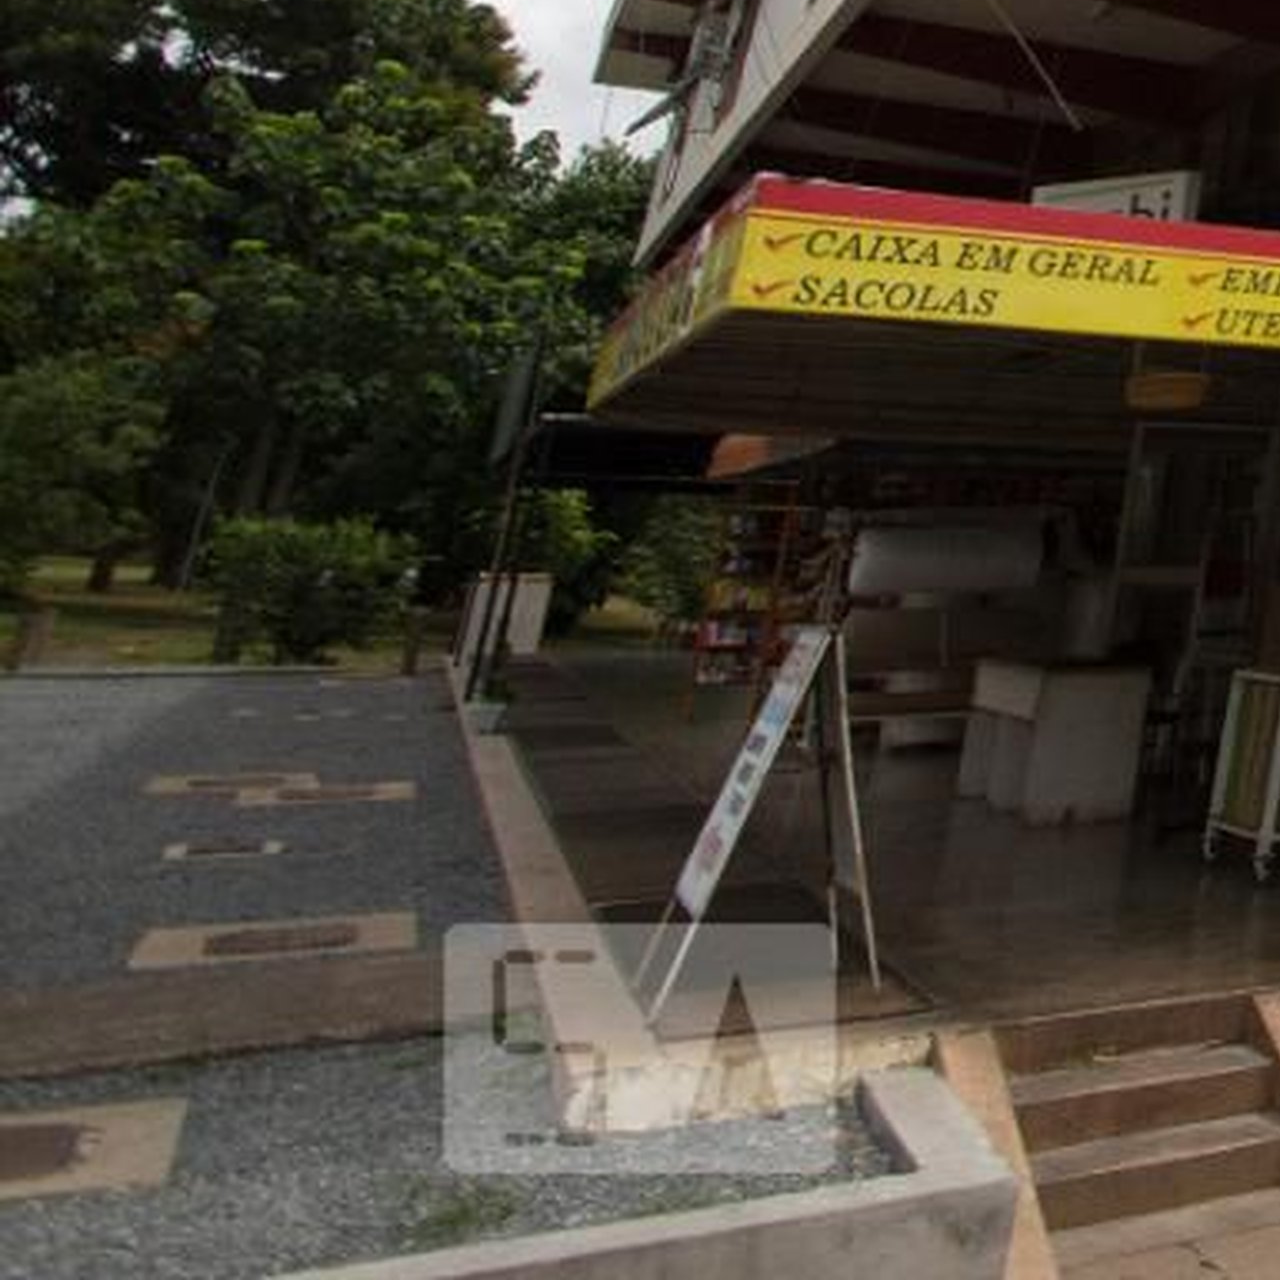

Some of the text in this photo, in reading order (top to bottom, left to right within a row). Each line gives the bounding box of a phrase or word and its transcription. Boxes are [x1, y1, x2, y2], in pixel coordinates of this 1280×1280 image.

[804, 228, 1162, 287] CAIXA EM GERAL
[792, 274, 998, 317] SACOLAS
